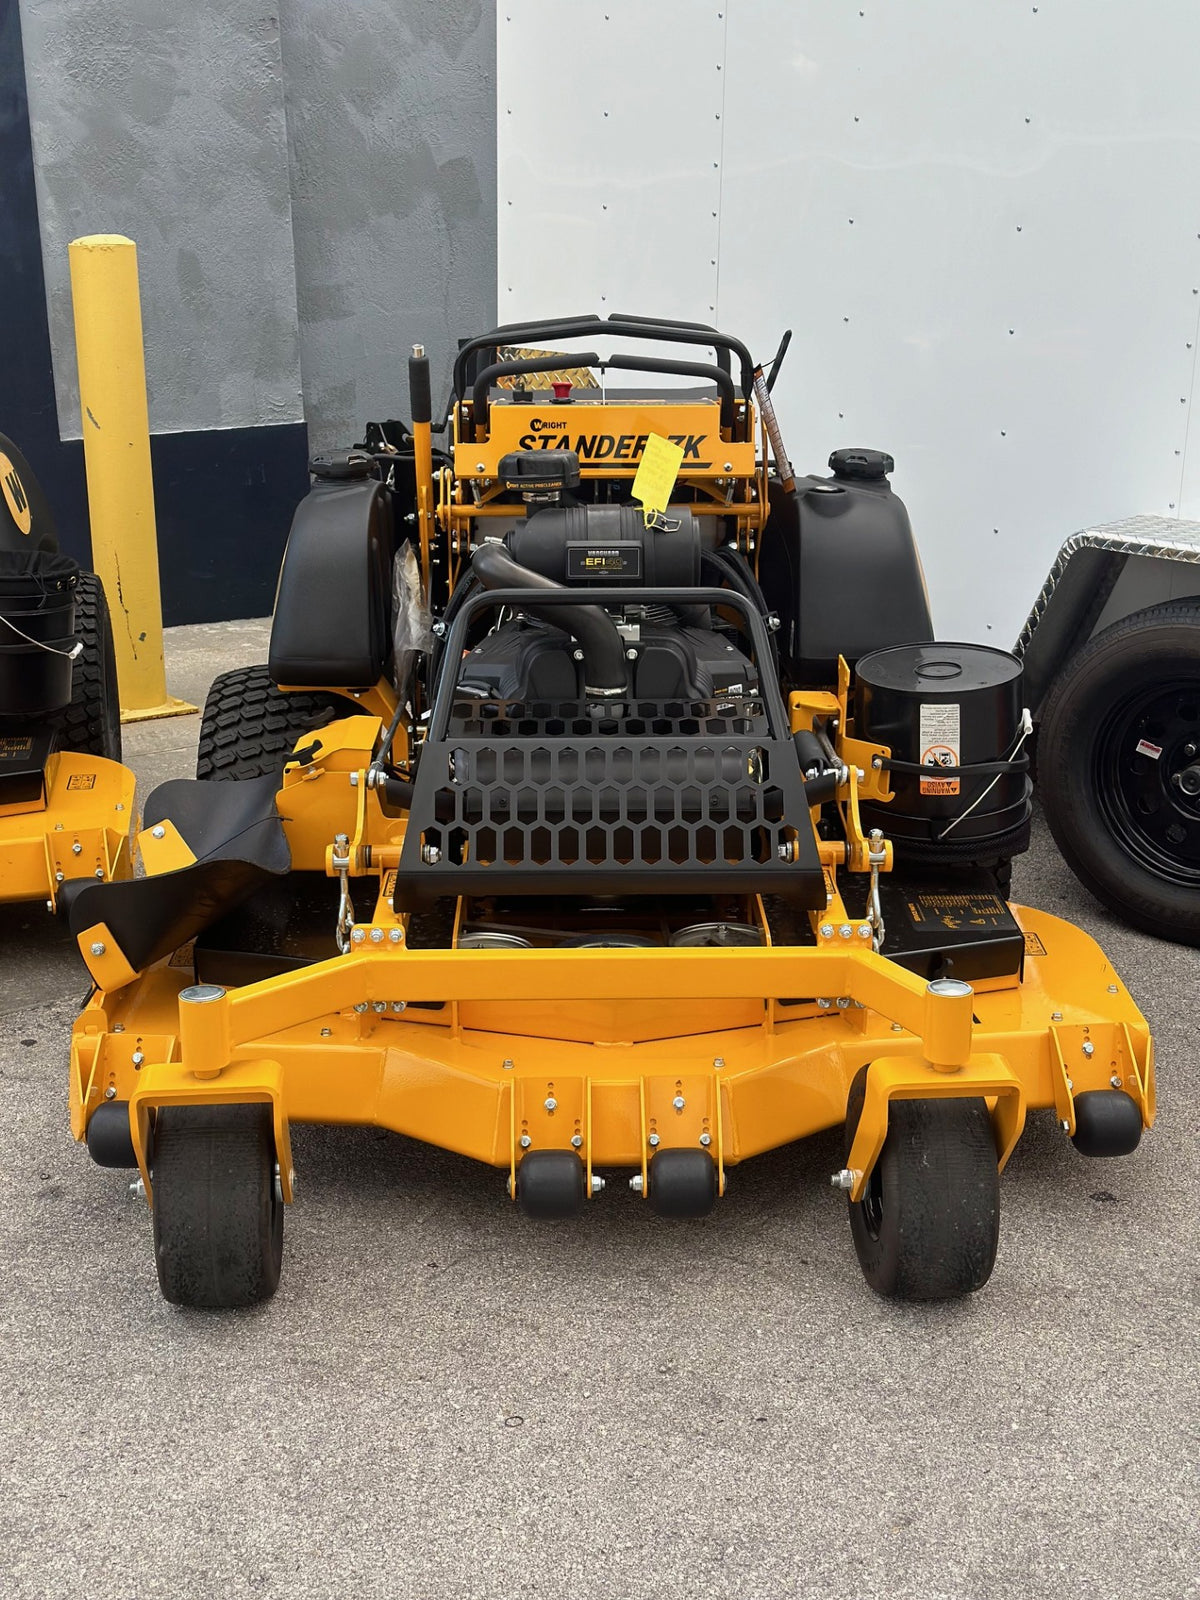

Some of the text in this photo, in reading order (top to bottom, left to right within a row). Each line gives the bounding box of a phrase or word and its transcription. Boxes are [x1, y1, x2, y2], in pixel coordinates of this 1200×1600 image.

[530, 418, 567, 432] WRIGHT
[519, 434, 648, 459] STANDER
[585, 557, 606, 566] EFI
